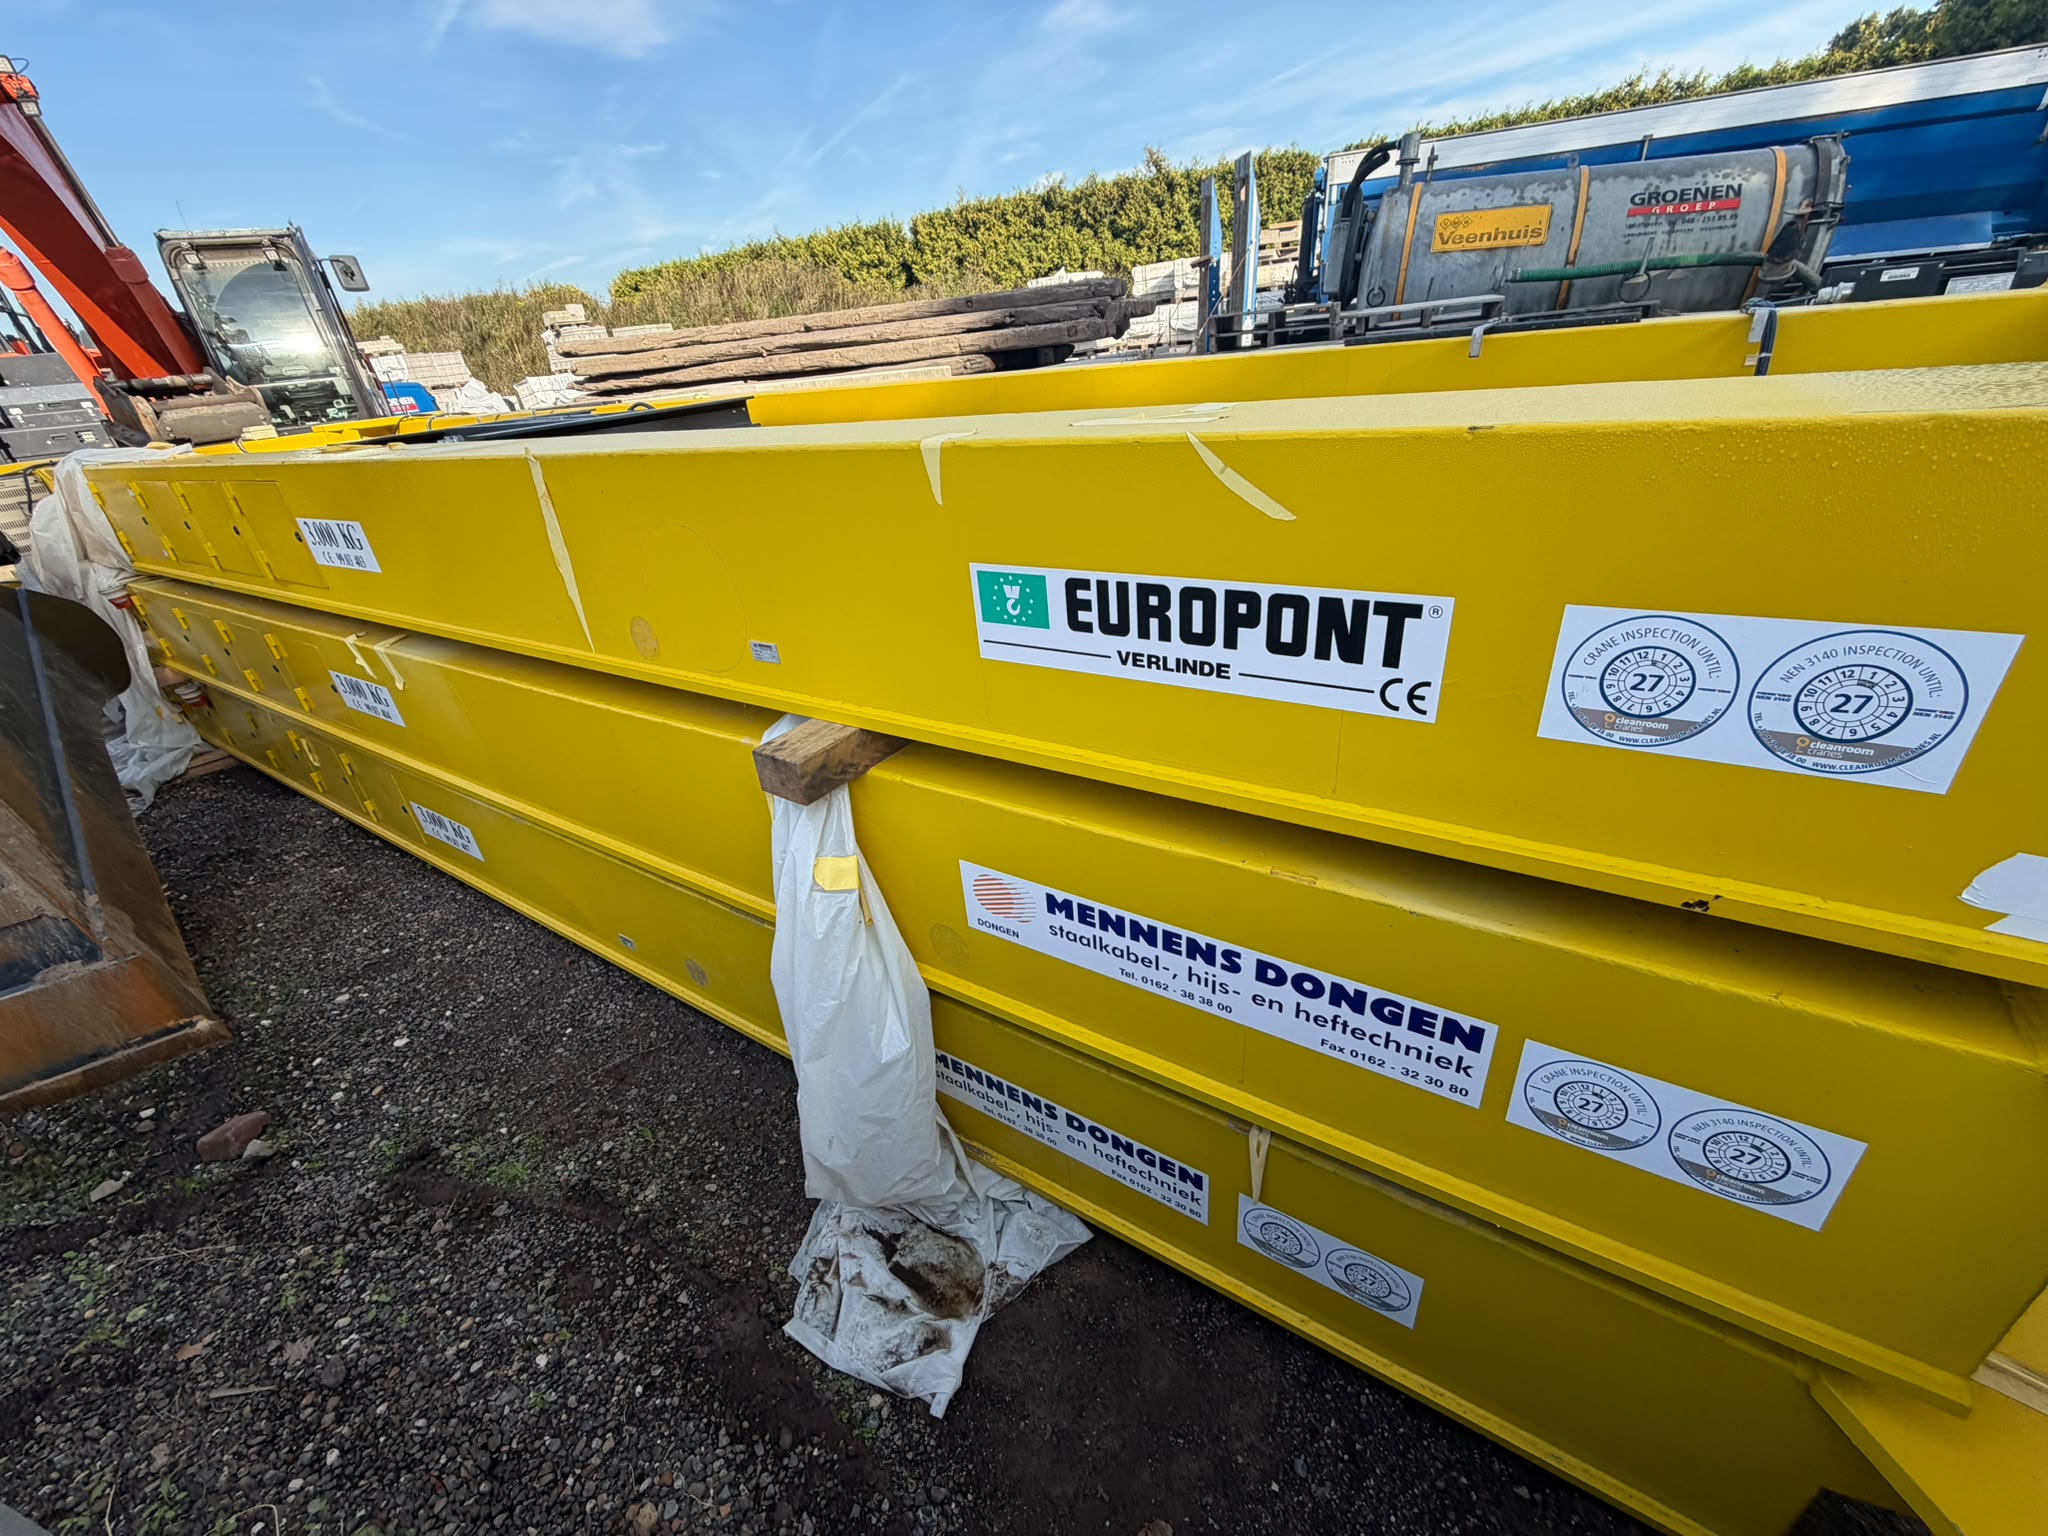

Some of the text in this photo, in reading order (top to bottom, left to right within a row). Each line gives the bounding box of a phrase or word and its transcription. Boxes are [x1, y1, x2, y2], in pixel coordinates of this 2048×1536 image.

[1630, 184, 1742, 206] GROENEN
[1652, 201, 1717, 214] GROEP
[1439, 225, 1543, 246] Veenhuis
[303, 521, 364, 550] 3.000 KG
[1065, 577, 1423, 669] EUROPONT
[1583, 636, 1620, 666] CRANE
[1621, 627, 1701, 649] INSPECTION
[1620, 656, 1632, 666] 11
[1637, 651, 1649, 660] 12
[1116, 650, 1232, 680] VERLINDE
[1673, 661, 1683, 670] 2
[1779, 663, 1806, 683] NEN
[1804, 648, 1839, 667] 3140
[1843, 645, 1924, 670] INSPECTION
[1608, 667, 1620, 677] 10
[1840, 669, 1855, 679] 12
[1869, 671, 1878, 680] 1
[1629, 673, 1665, 692] 27
[1818, 675, 1833, 686] 11
[1884, 680, 1897, 689] 2
[335, 674, 390, 708] 3.000 KG
[1803, 688, 1818, 698] 10
[1627, 703, 1635, 711] 7
[1645, 705, 1653, 713] 6
[1663, 700, 1672, 708] 5
[1830, 693, 1874, 714] 27
[1809, 718, 1820, 726] 8
[1886, 711, 1898, 719] 4
[1614, 723, 1644, 733] cranes
[1615, 717, 1670, 731] cleanroom
[1826, 727, 1836, 735] 7
[1871, 722, 1882, 732] 5
[1849, 728, 1857, 737] 6
[1807, 748, 1843, 759] cranes
[1809, 741, 1875, 756] cleanroom
[448, 820, 471, 844] KG
[977, 917, 1020, 939] DONGEN
[1045, 892, 1486, 1054] MENNENS DONGEN
[1118, 967, 1233, 1014] Tel. 0162 38 38 00
[1049, 924, 1474, 1079] staalkabel-, hijs- en heftechniek
[1320, 1038, 1469, 1097] Fax 0162 32 30 80
[1540, 1067, 1568, 1084] CRANE
[1569, 1067, 1631, 1093] INSPECTION
[1578, 1097, 1604, 1113] 27
[935, 1053, 1203, 1192] MENNENS DONGEN
[1691, 1121, 1710, 1133] NEN
[1710, 1118, 1734, 1127] 3140
[1737, 1119, 1798, 1146] INSPECTION
[1025, 1111, 1060, 1135] hijs-
[1066, 1134, 1087, 1150] en
[1093, 1143, 1202, 1207] heftechniek
[1729, 1148, 1762, 1165] 27
[1716, 1174, 1765, 1195] cleanroom
[1111, 1169, 1202, 1218] Fax 0162 32 30 80
[1274, 1233, 1288, 1244] 27
[1360, 1274, 1376, 1286] 27
